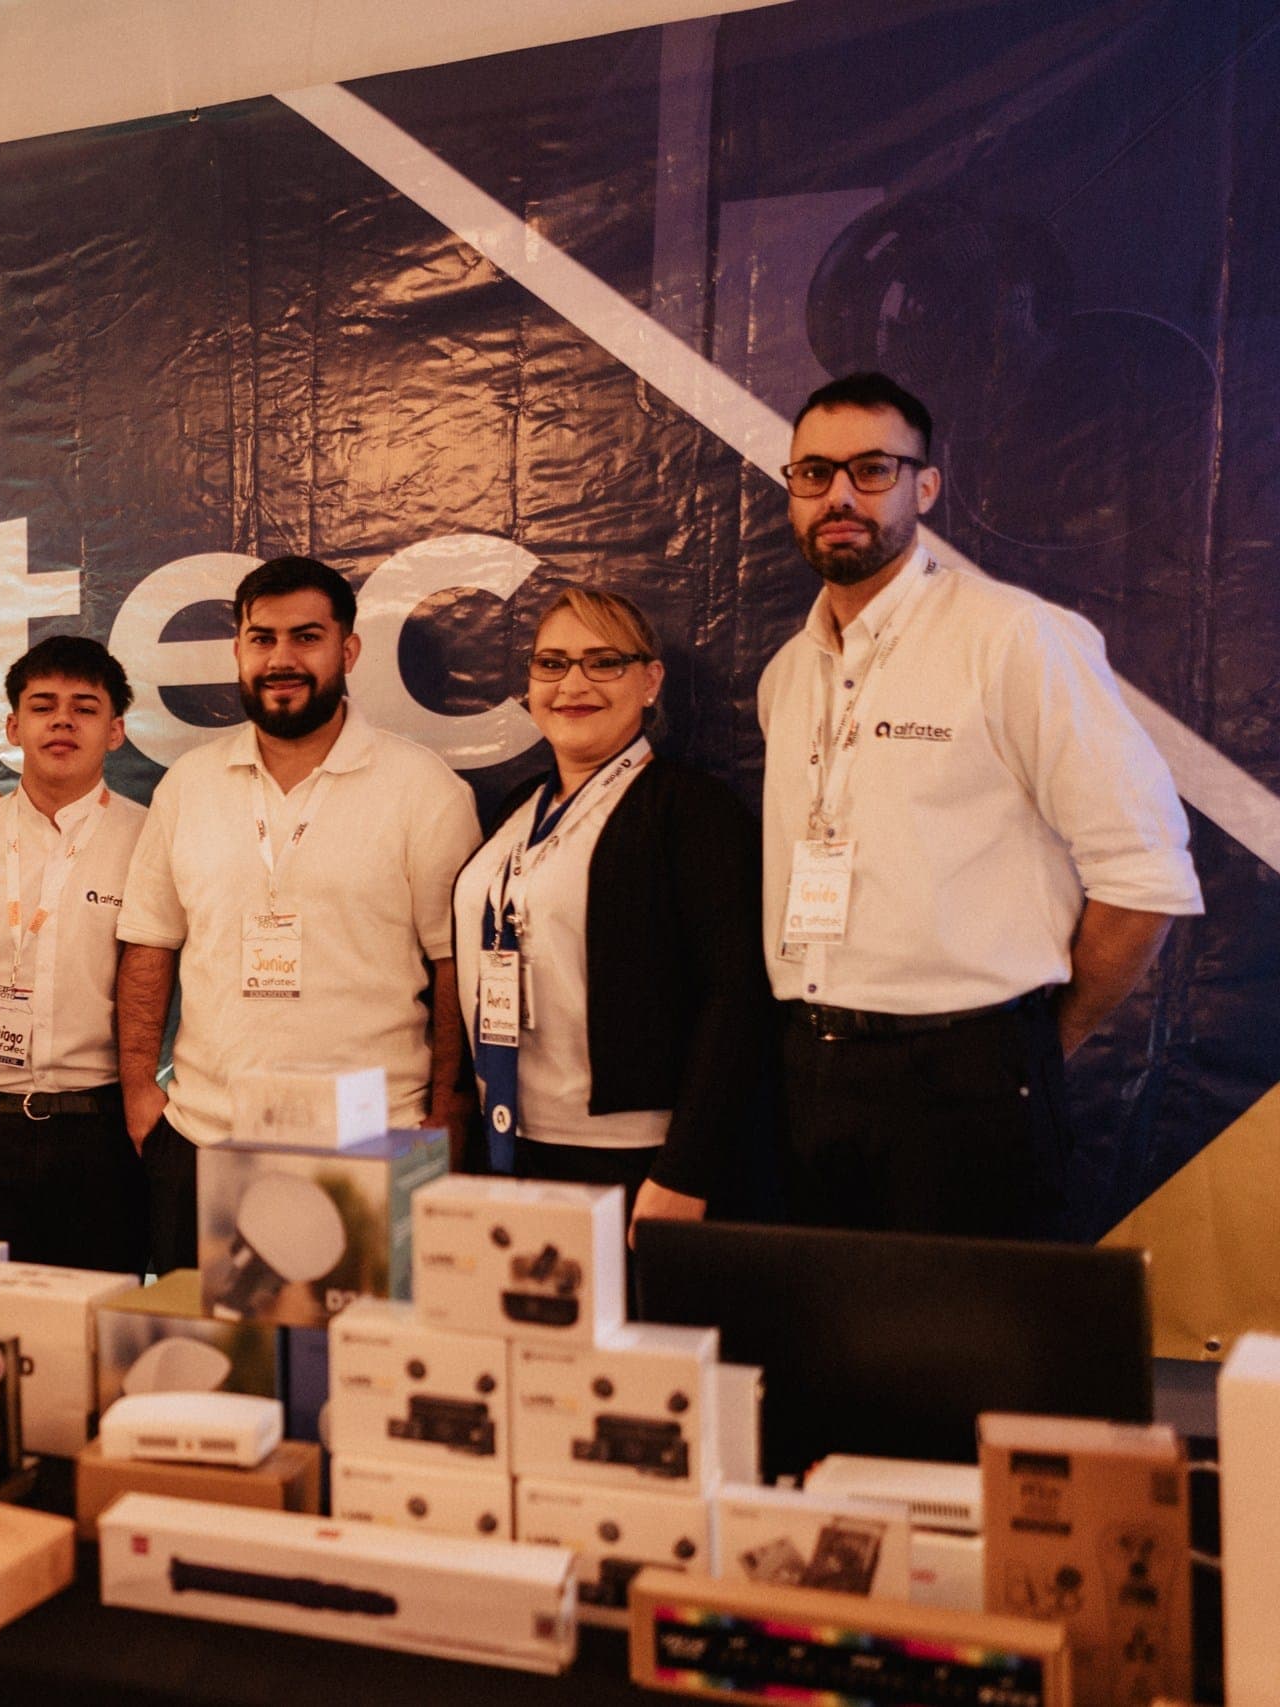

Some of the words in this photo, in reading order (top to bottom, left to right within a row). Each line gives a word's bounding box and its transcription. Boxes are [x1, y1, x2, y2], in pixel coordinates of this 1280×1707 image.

[894, 722, 953, 738] alfatec
[252, 948, 297, 973] Junior
[261, 977, 297, 987] alfatec
